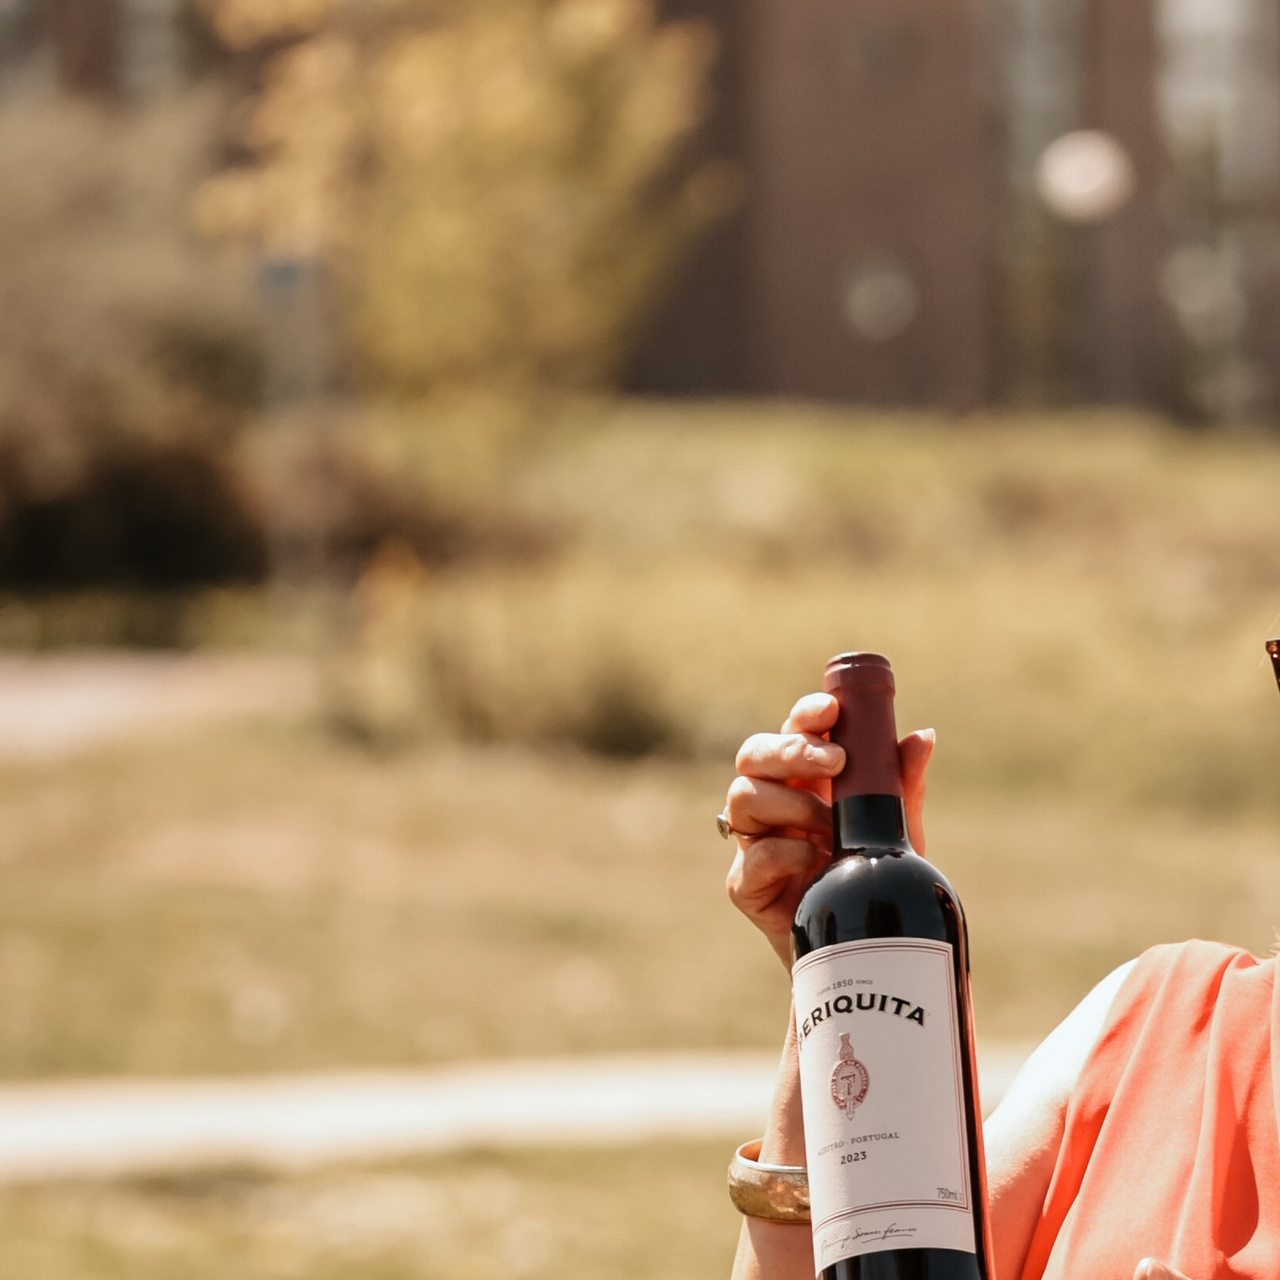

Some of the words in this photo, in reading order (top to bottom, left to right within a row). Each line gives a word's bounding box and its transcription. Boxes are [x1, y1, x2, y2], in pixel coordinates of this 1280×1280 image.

[832, 979, 853, 990] 1850
[850, 1132, 900, 1144] PORTUGAL
[840, 1151, 867, 1165] 2023
